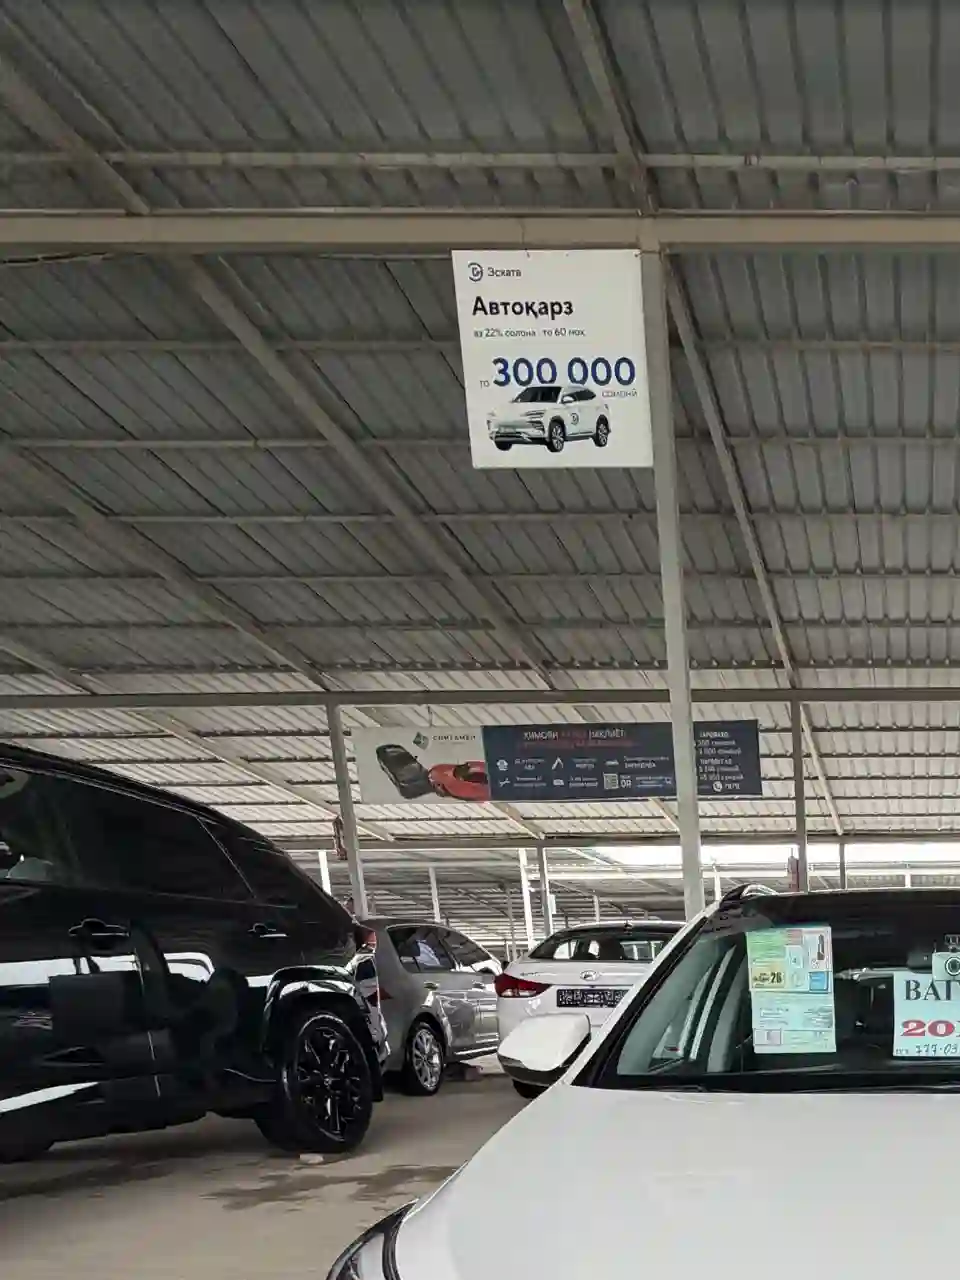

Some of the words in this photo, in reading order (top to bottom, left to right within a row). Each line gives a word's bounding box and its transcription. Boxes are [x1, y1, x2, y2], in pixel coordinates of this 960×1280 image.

[554, 327, 566, 337] 60
[492, 356, 558, 387] 300
[567, 356, 636, 386] 000
